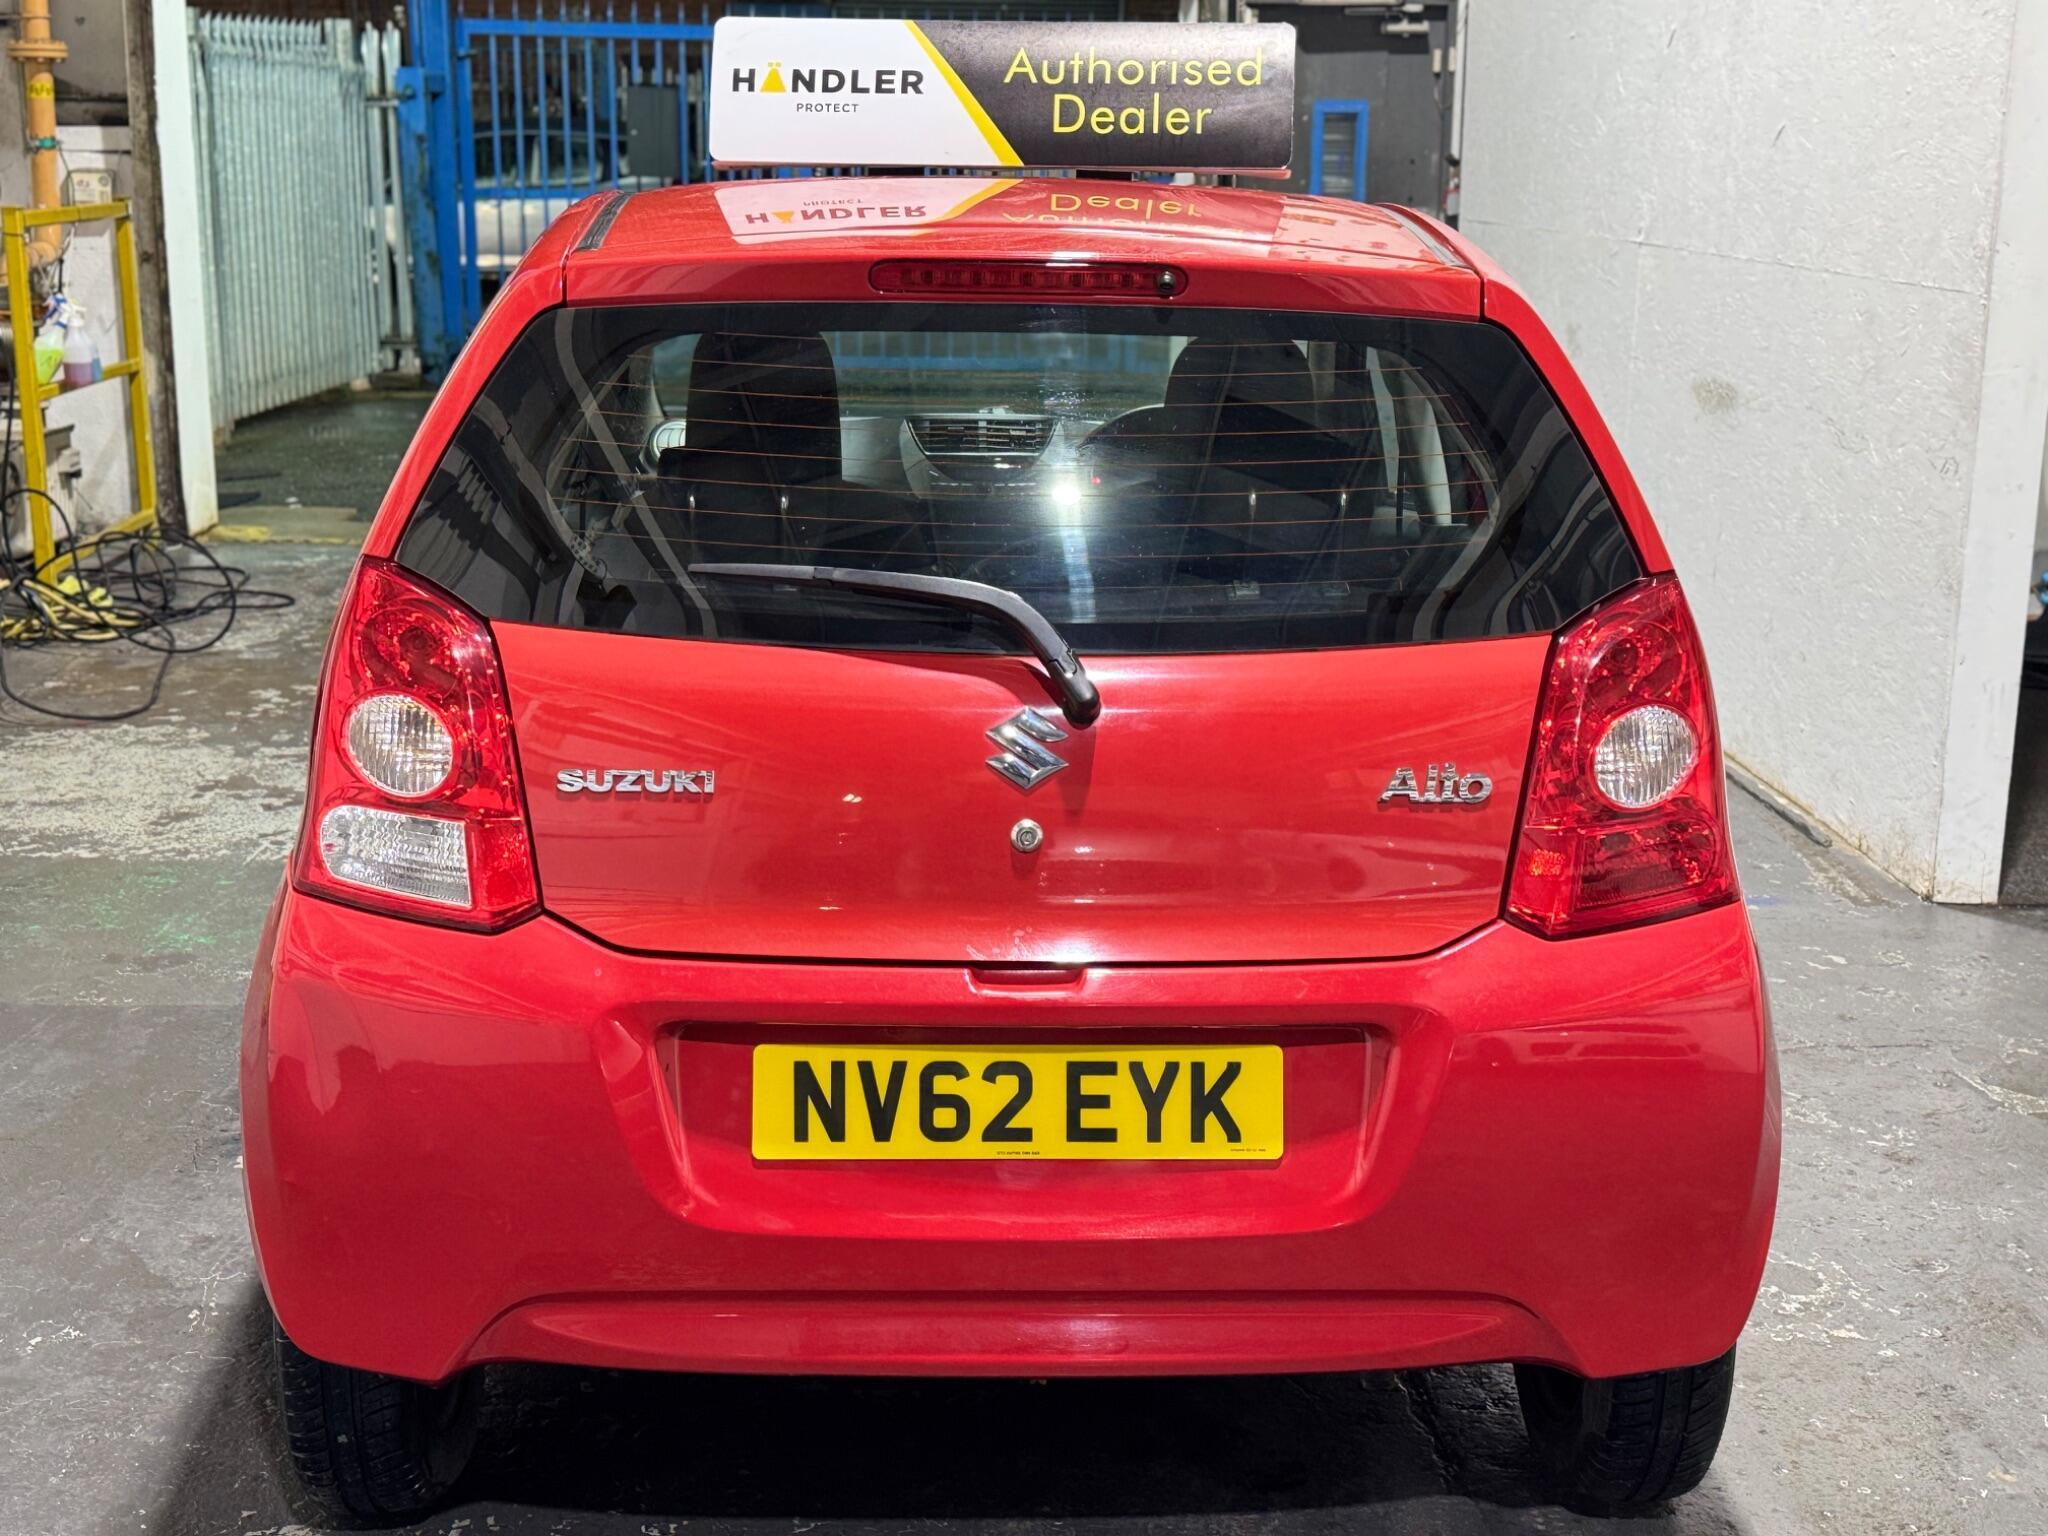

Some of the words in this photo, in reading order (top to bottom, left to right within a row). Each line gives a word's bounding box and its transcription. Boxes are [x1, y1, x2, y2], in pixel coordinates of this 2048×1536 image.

[1003, 46, 1263, 86] Authorised
[796, 103, 859, 113] PROTECT
[1052, 91, 1213, 135] Dealer
[556, 768, 715, 794] SUZUKI
[1377, 762, 1493, 804] Alto
[793, 1060, 1033, 1143] NV62
[1066, 1060, 1242, 1144] EYK
